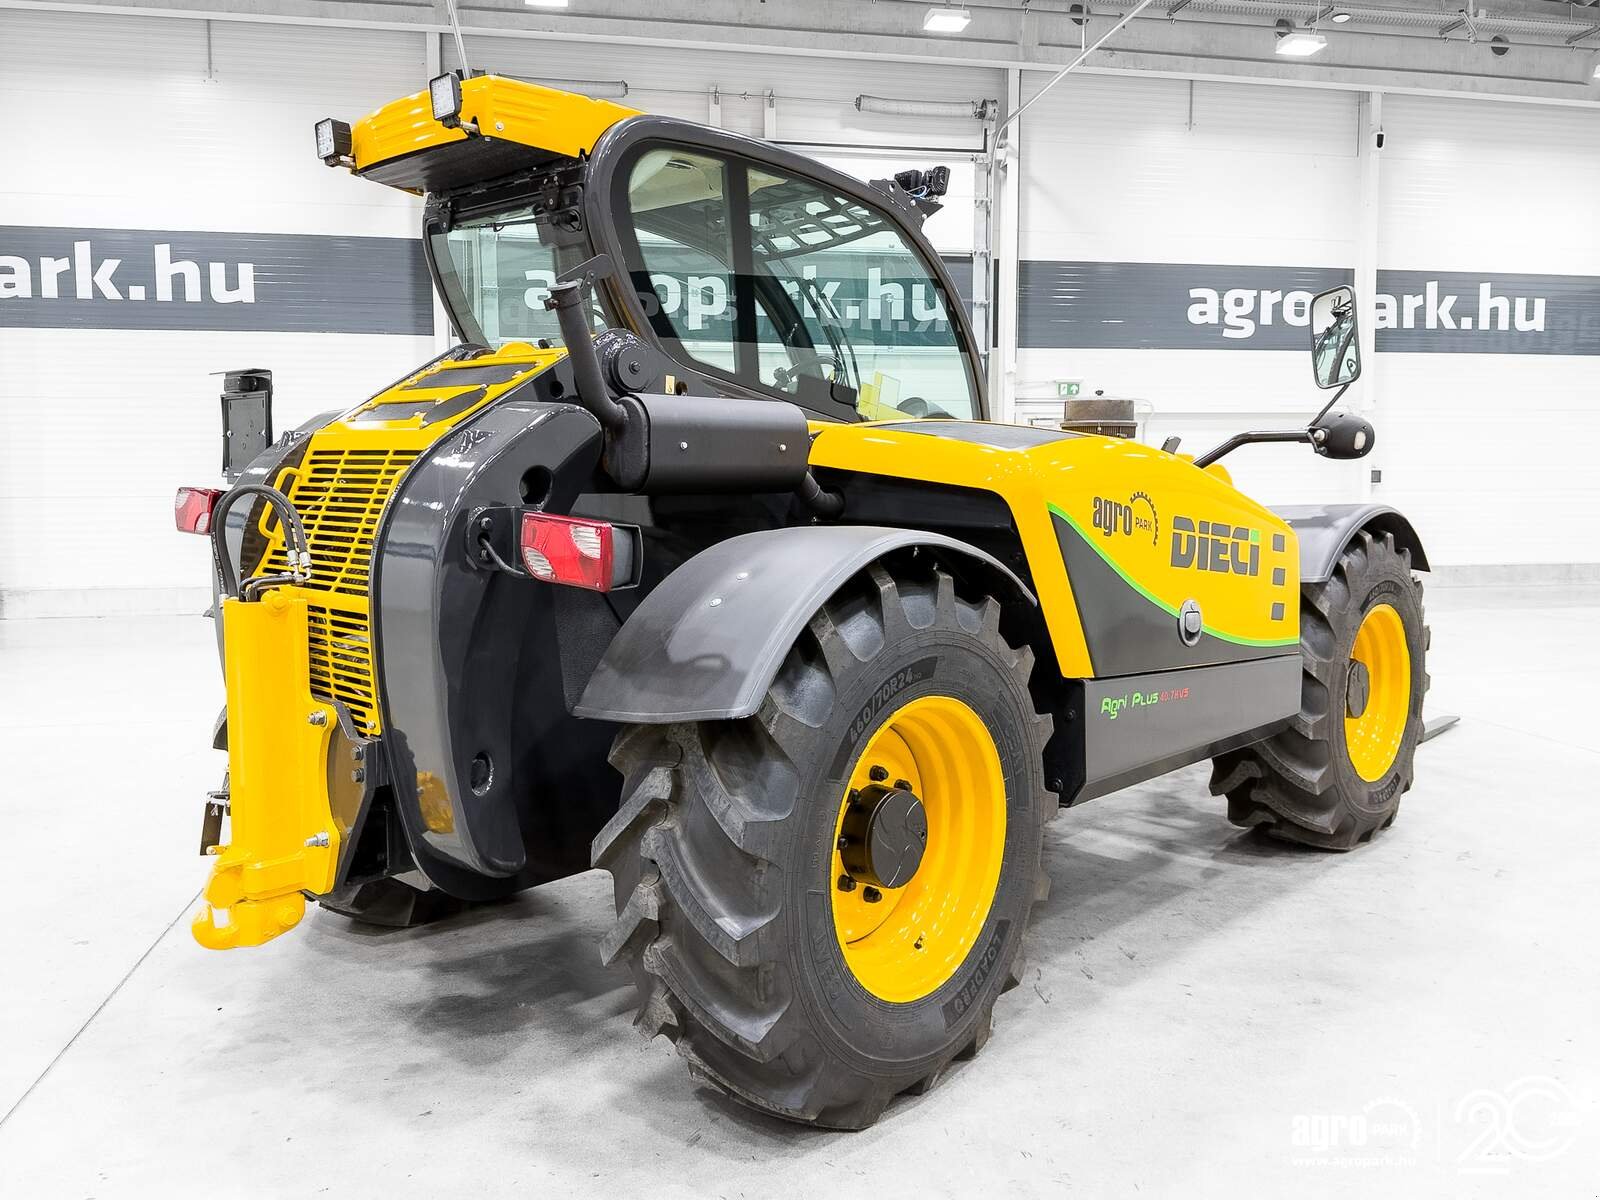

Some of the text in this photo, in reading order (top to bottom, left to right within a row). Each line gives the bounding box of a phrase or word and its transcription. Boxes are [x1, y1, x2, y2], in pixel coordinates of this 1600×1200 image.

[0, 240, 256, 304] ark.hu
[1187, 280, 1546, 339] agroark.hu
[1093, 496, 1153, 537] agro PARK
[848, 666, 913, 745] 460/70R24
[953, 933, 1004, 1016] LOADPRO
